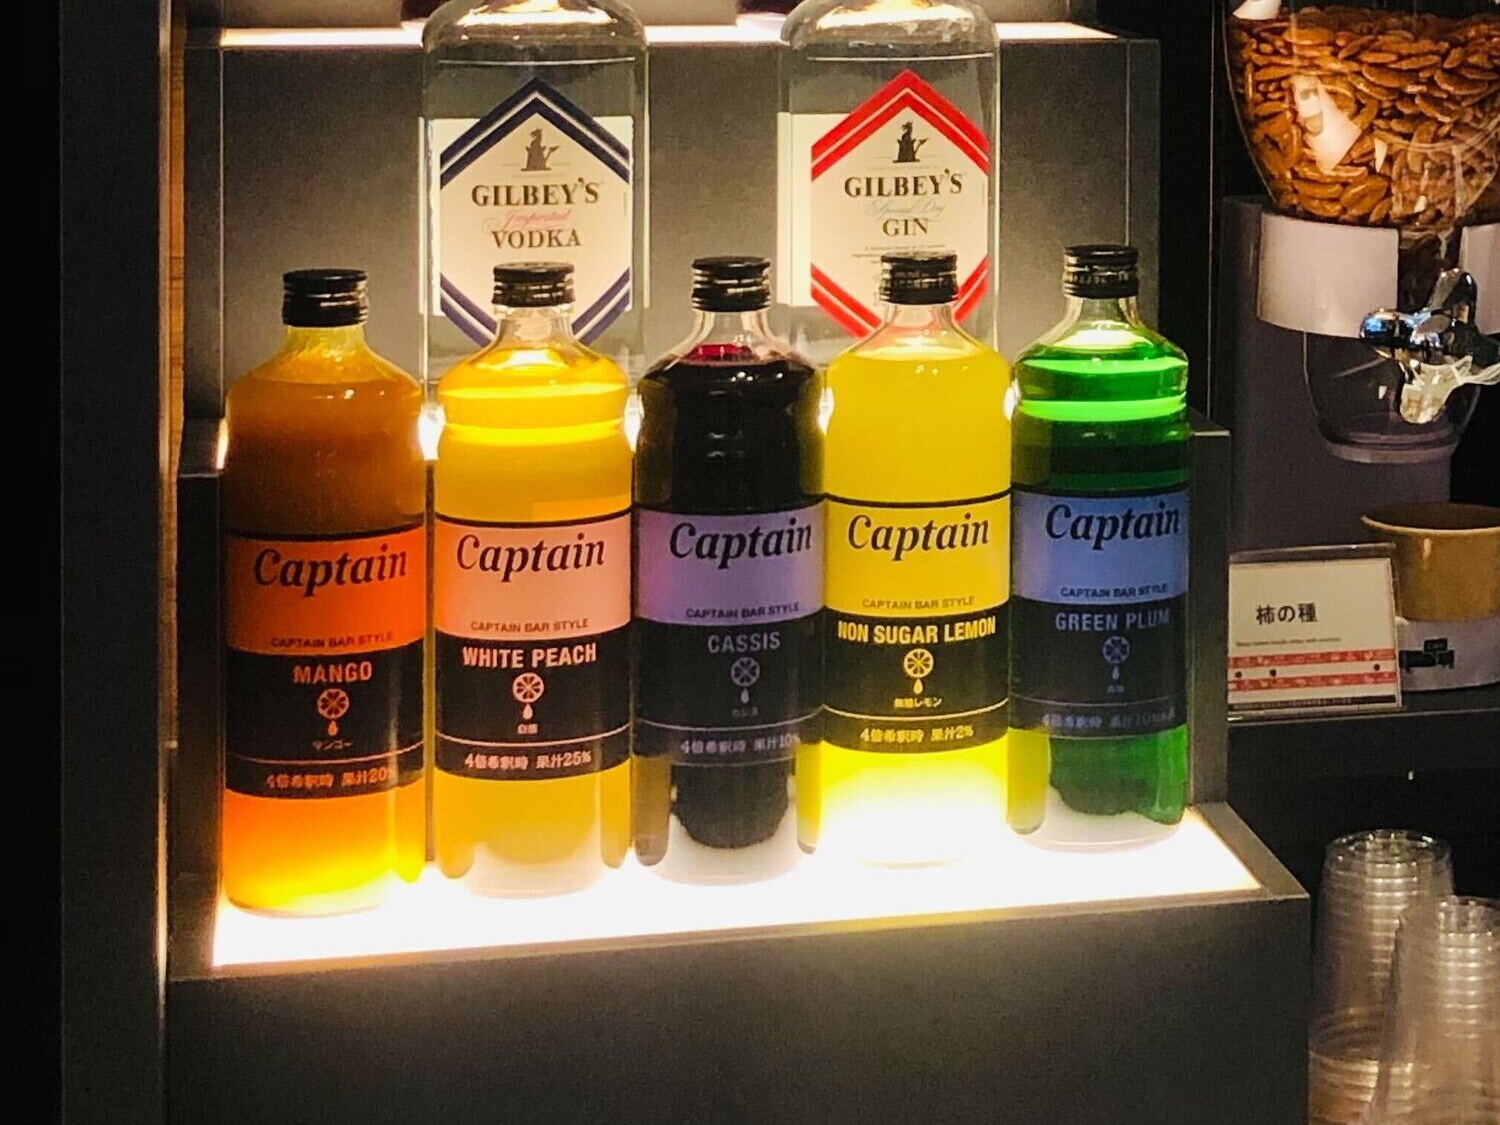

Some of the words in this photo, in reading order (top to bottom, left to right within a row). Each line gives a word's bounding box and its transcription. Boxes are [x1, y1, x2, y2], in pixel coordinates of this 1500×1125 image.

[471, 177, 600, 207] GILBEY'S
[844, 168, 963, 198] GILBEY'S
[491, 229, 581, 249] VODKA
[882, 218, 928, 237] GIN
[848, 512, 990, 562] Captain
[1045, 500, 1180, 552] Captain
[669, 517, 812, 570] Captain
[456, 532, 605, 583] Captain
[254, 543, 406, 597] Captain
[1060, 587, 1111, 598] CAPTAIN
[1113, 586, 1138, 598] BAR
[1138, 583, 1169, 595] STYLE
[685, 607, 738, 619] CAPTAIN
[741, 606, 767, 618] BAR
[767, 602, 800, 615] STYLE
[861, 598, 912, 610] CAPTAIN
[914, 598, 940, 610] BAR
[942, 595, 975, 608] STYLE
[1255, 602, 1318, 625] 柿の種
[470, 620, 521, 633] CAPTAIN
[524, 621, 550, 633] BAR
[553, 618, 589, 630] STYLE
[837, 620, 870, 643] NON
[872, 625, 939, 645] SUGAR
[943, 615, 997, 643] LEMON
[1055, 612, 1118, 632] GREEN
[1125, 608, 1171, 630] PLUM
[270, 637, 325, 648] CAPTAIN
[328, 635, 356, 647] BAR
[358, 632, 393, 646] STYLE
[707, 631, 781, 653] CASSIS
[462, 646, 525, 669] WHITE
[531, 642, 597, 668] PEACH
[292, 661, 373, 684] MANGO
